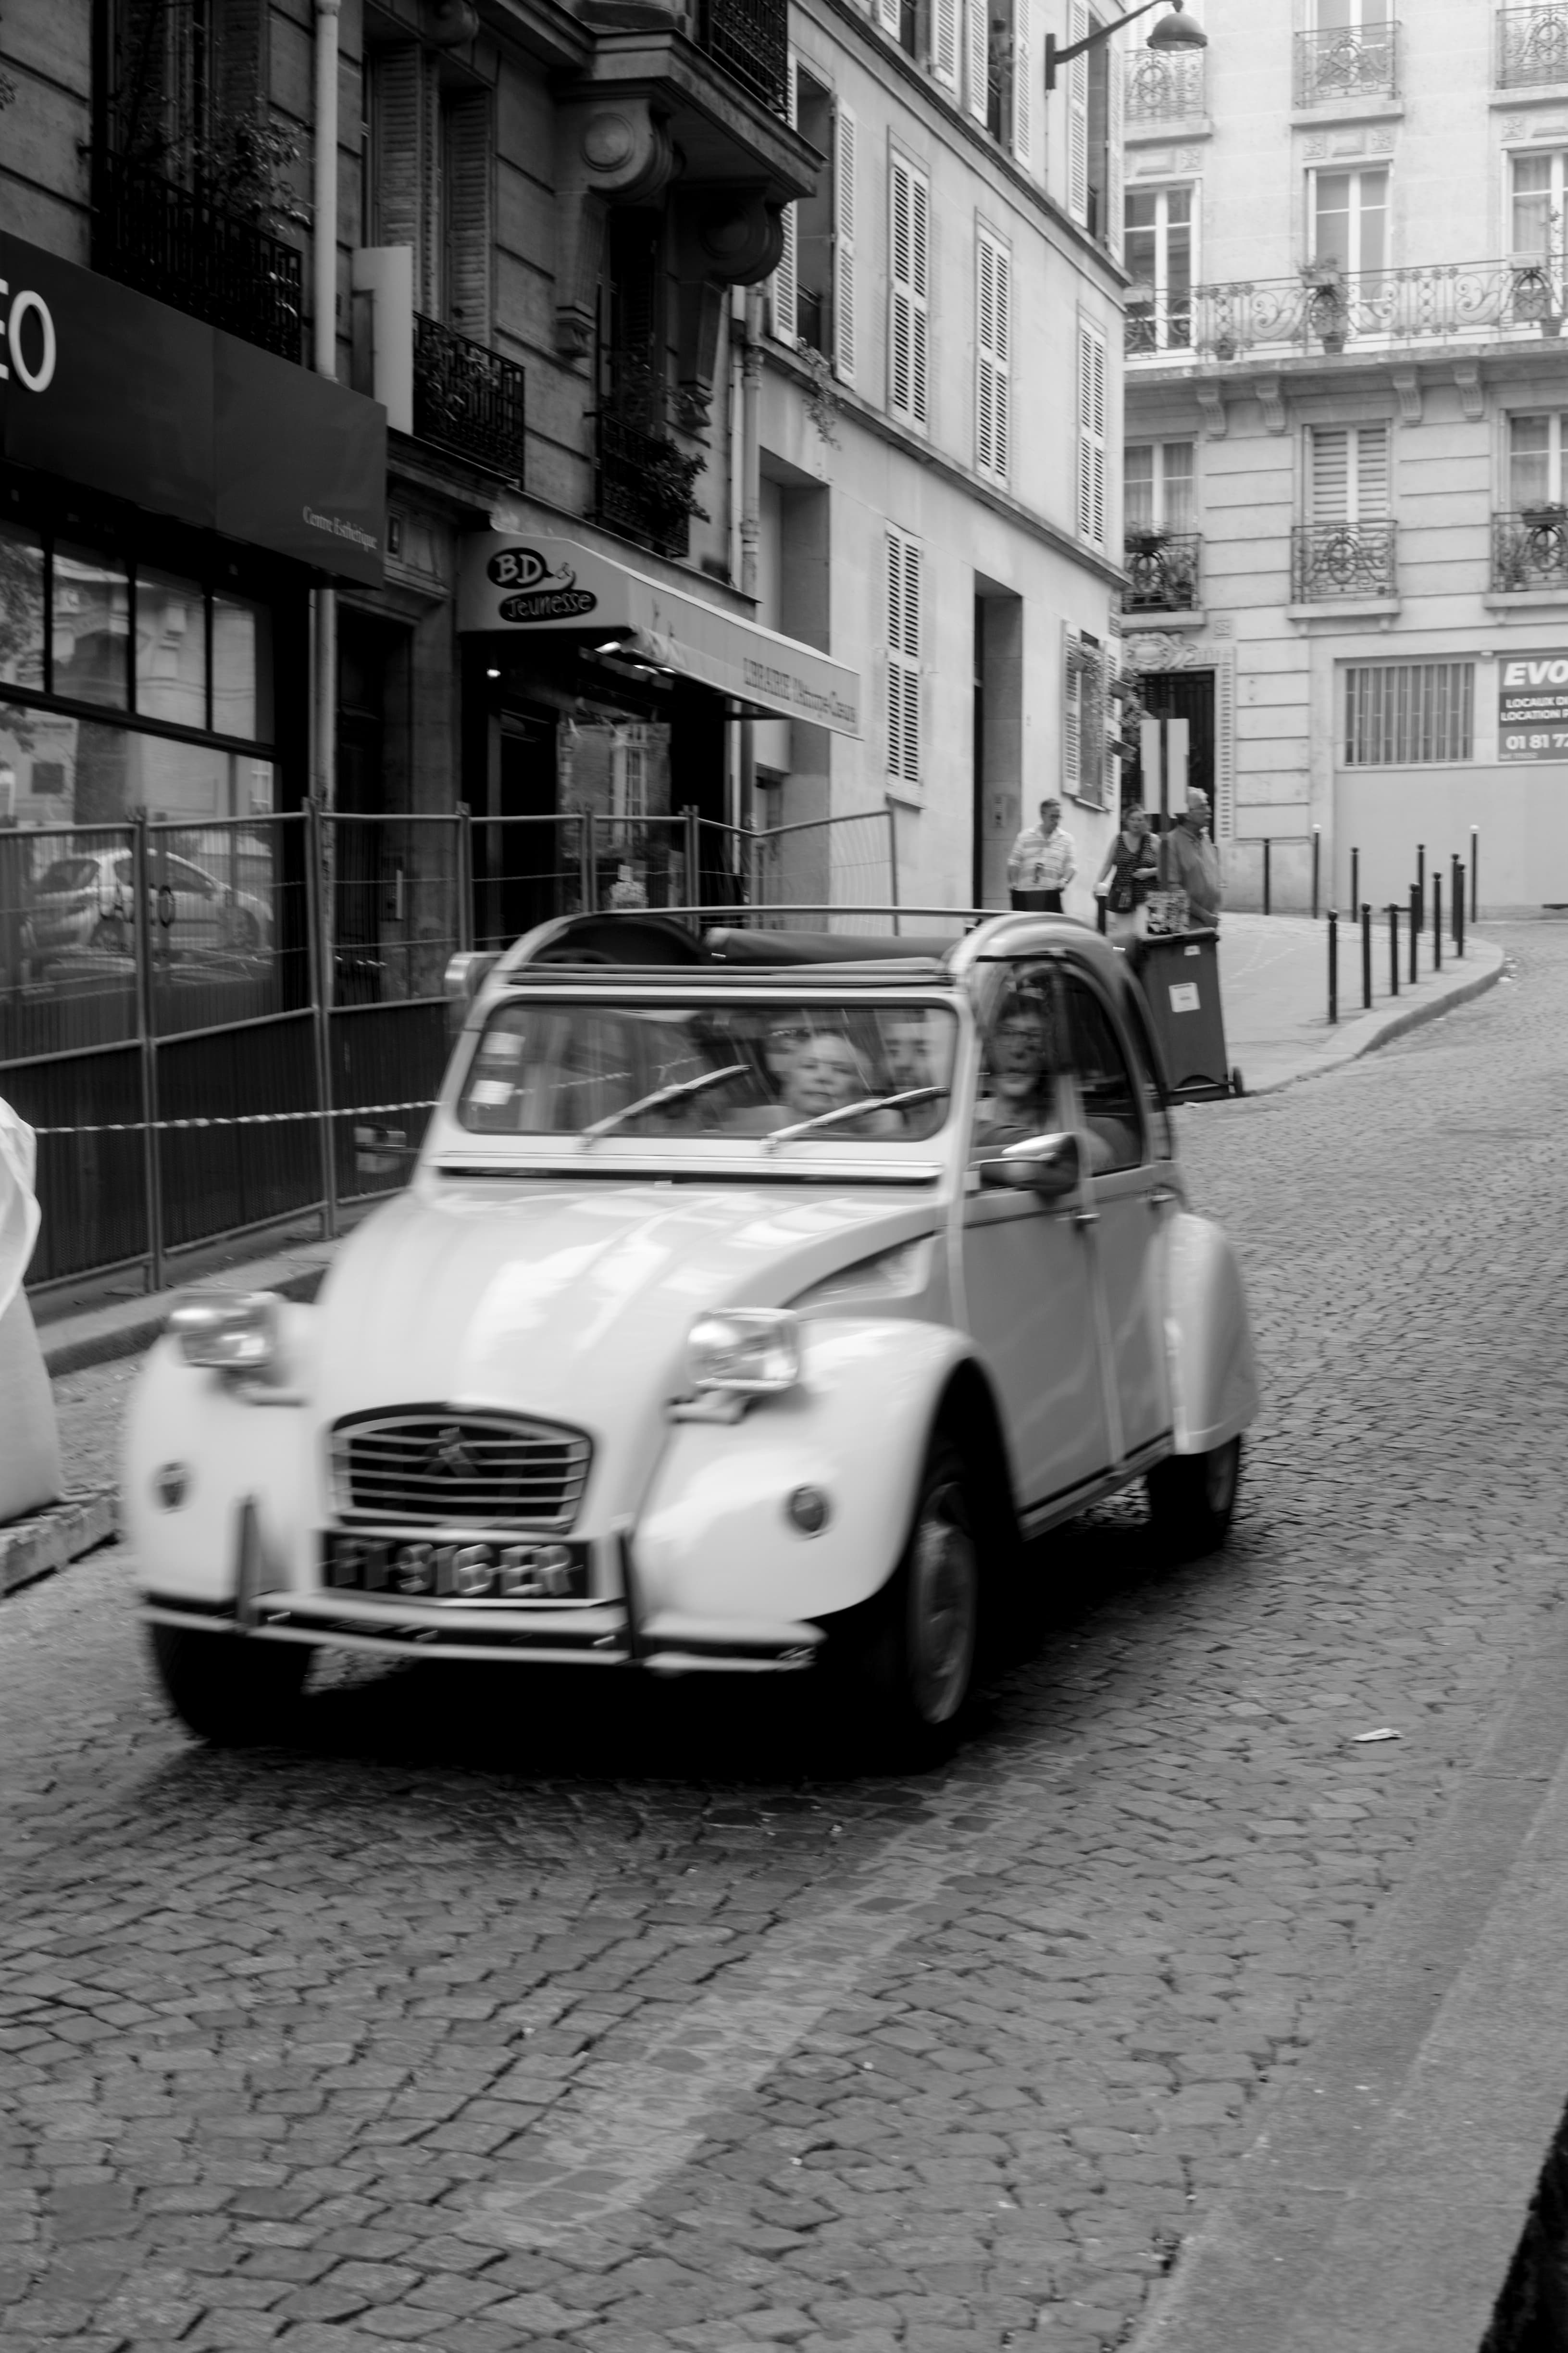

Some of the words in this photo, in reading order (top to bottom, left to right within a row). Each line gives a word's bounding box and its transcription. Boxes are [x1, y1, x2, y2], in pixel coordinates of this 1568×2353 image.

[0, 278, 56, 392] O
[302, 505, 333, 533] Centre
[495, 553, 543, 584] BD
[505, 593, 592, 617] Jeunesse
[743, 657, 790, 701] LIBRAIRIE
[1500, 709, 1561, 721] LOCATION
[1506, 697, 1556, 708] LOCAUX
[1506, 735, 1526, 750] 01
[1529, 734, 1550, 749] 81
